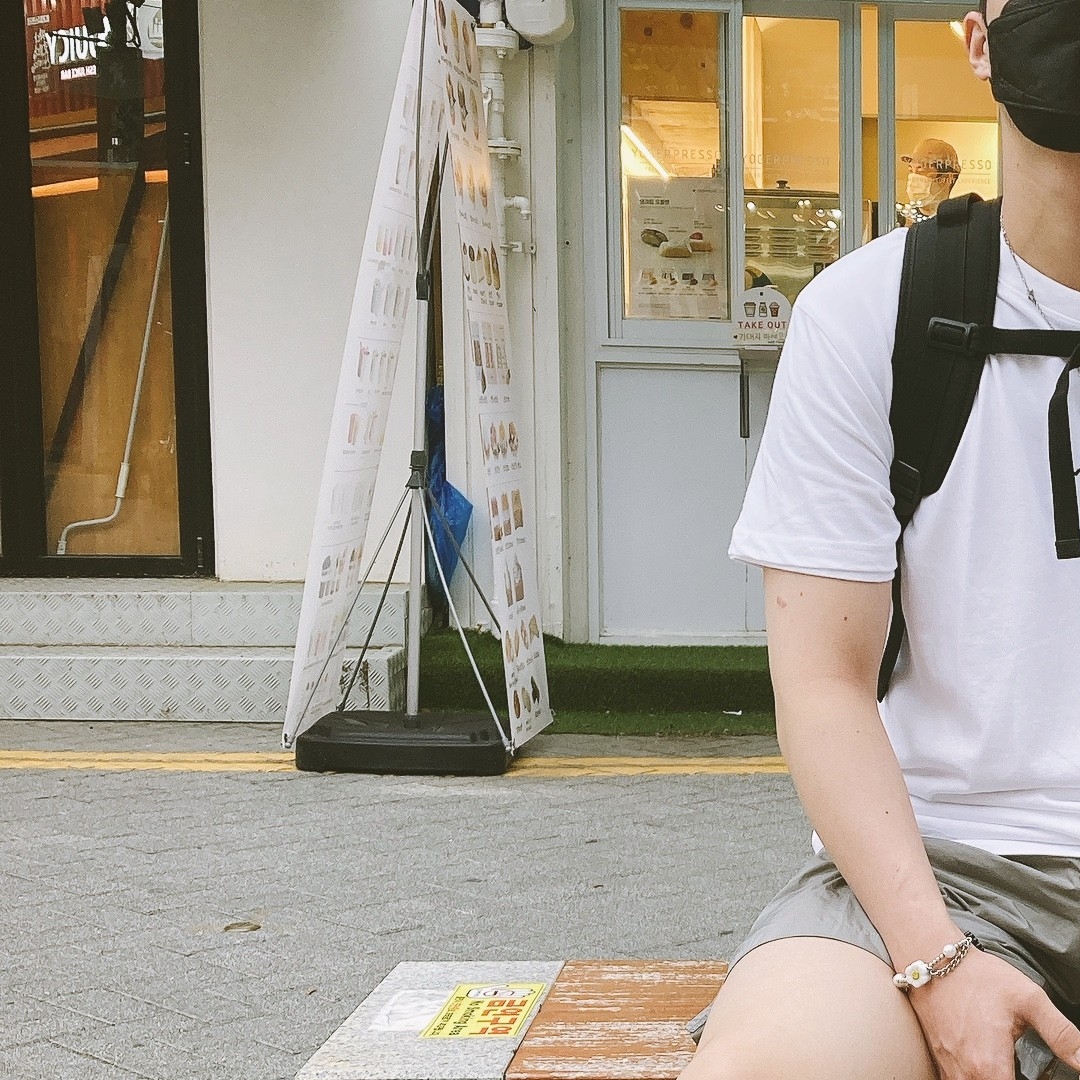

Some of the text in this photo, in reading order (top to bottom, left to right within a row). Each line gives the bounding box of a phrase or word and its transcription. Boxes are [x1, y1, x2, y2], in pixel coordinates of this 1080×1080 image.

[738, 321, 788, 329] TAKE OUT
[740, 332, 761, 341] 기대지
[469, 999, 529, 1035] 금연구역
